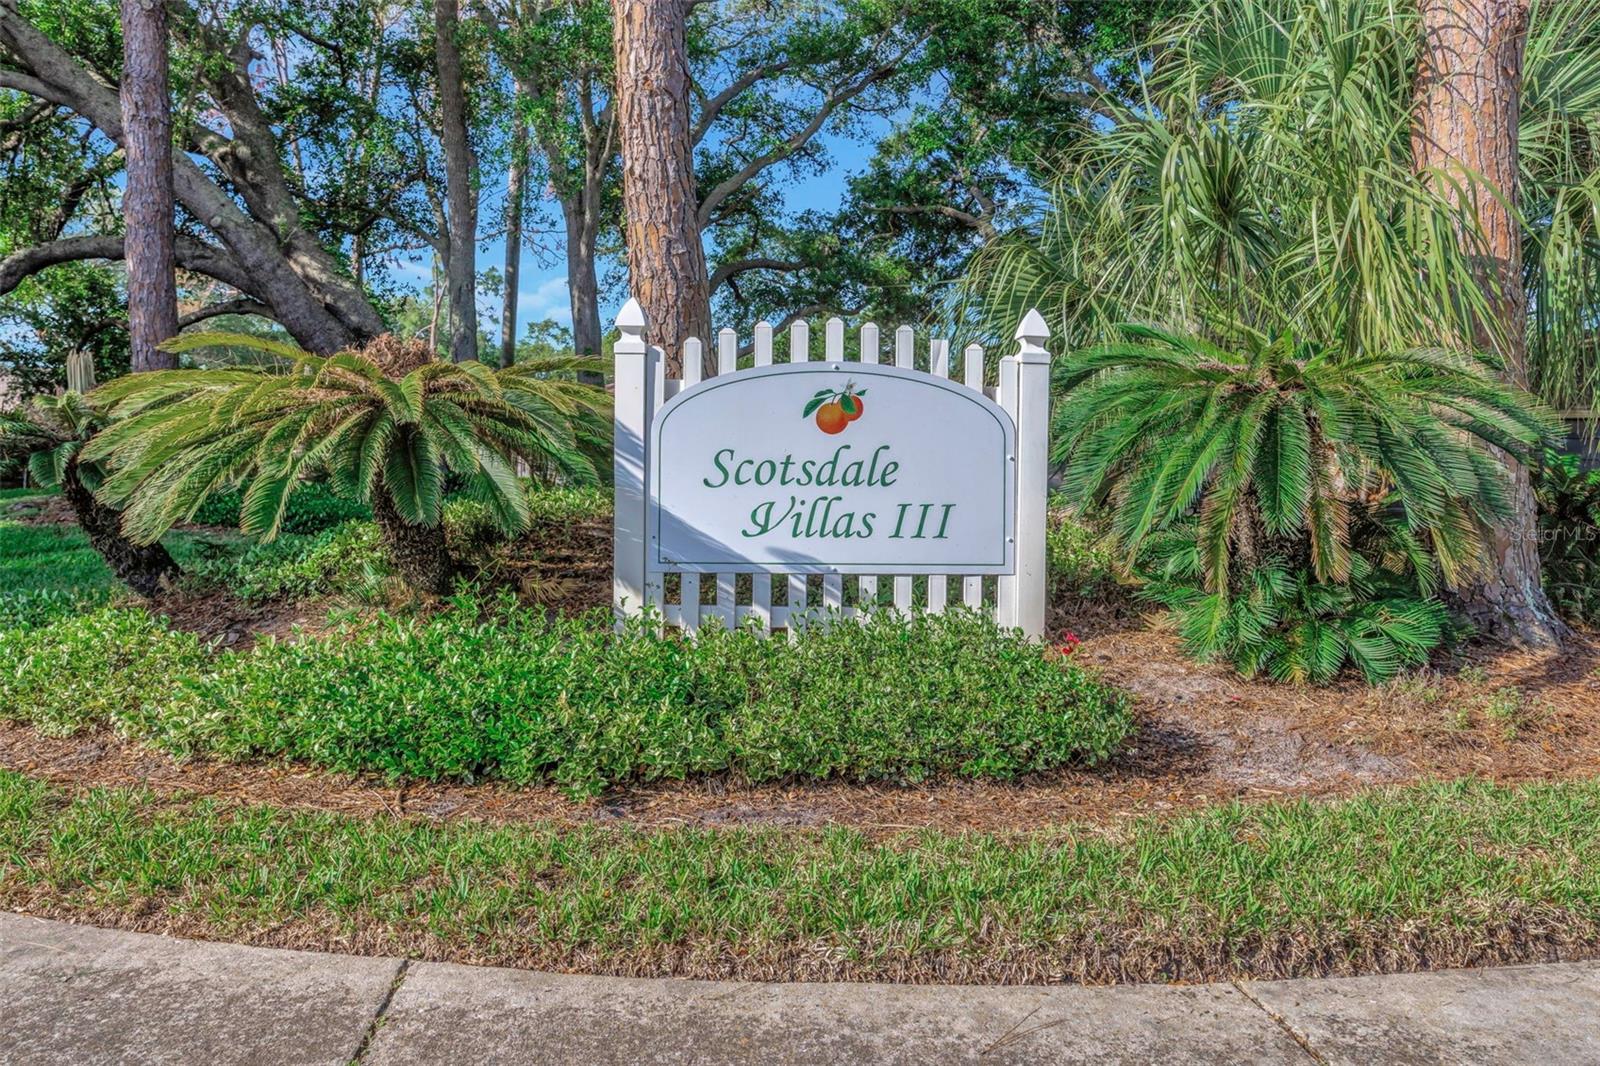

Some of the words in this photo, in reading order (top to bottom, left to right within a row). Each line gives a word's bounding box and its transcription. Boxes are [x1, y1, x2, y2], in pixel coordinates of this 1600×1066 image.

[703, 444, 900, 489] Scotsdale
[741, 495, 877, 539] Villas
[888, 502, 957, 539] III
